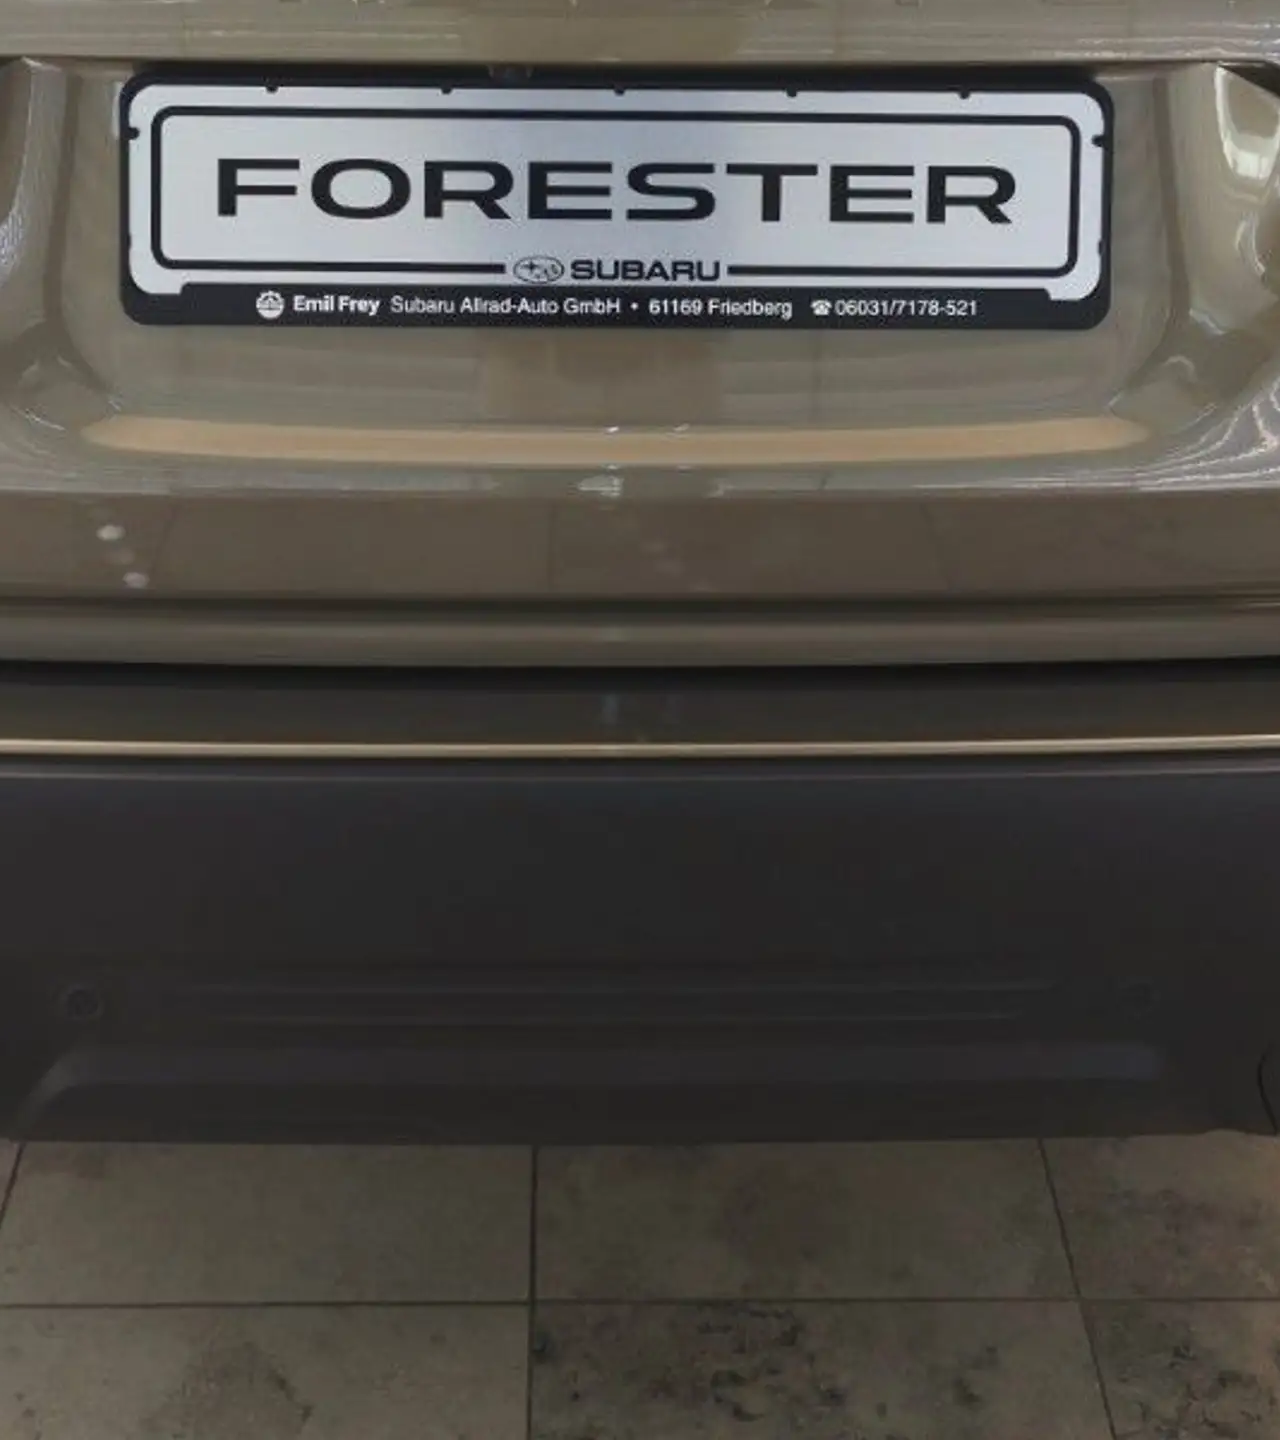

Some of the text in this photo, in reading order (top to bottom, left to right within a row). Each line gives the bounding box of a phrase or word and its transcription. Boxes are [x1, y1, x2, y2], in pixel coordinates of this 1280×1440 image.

[217, 158, 1018, 225] FORESTER
[570, 259, 721, 283] SUBARU
[293, 295, 978, 321] Emil Frey Subaru Allrad-Auto GmbH 61169 Friedberg 06031/7178-521
